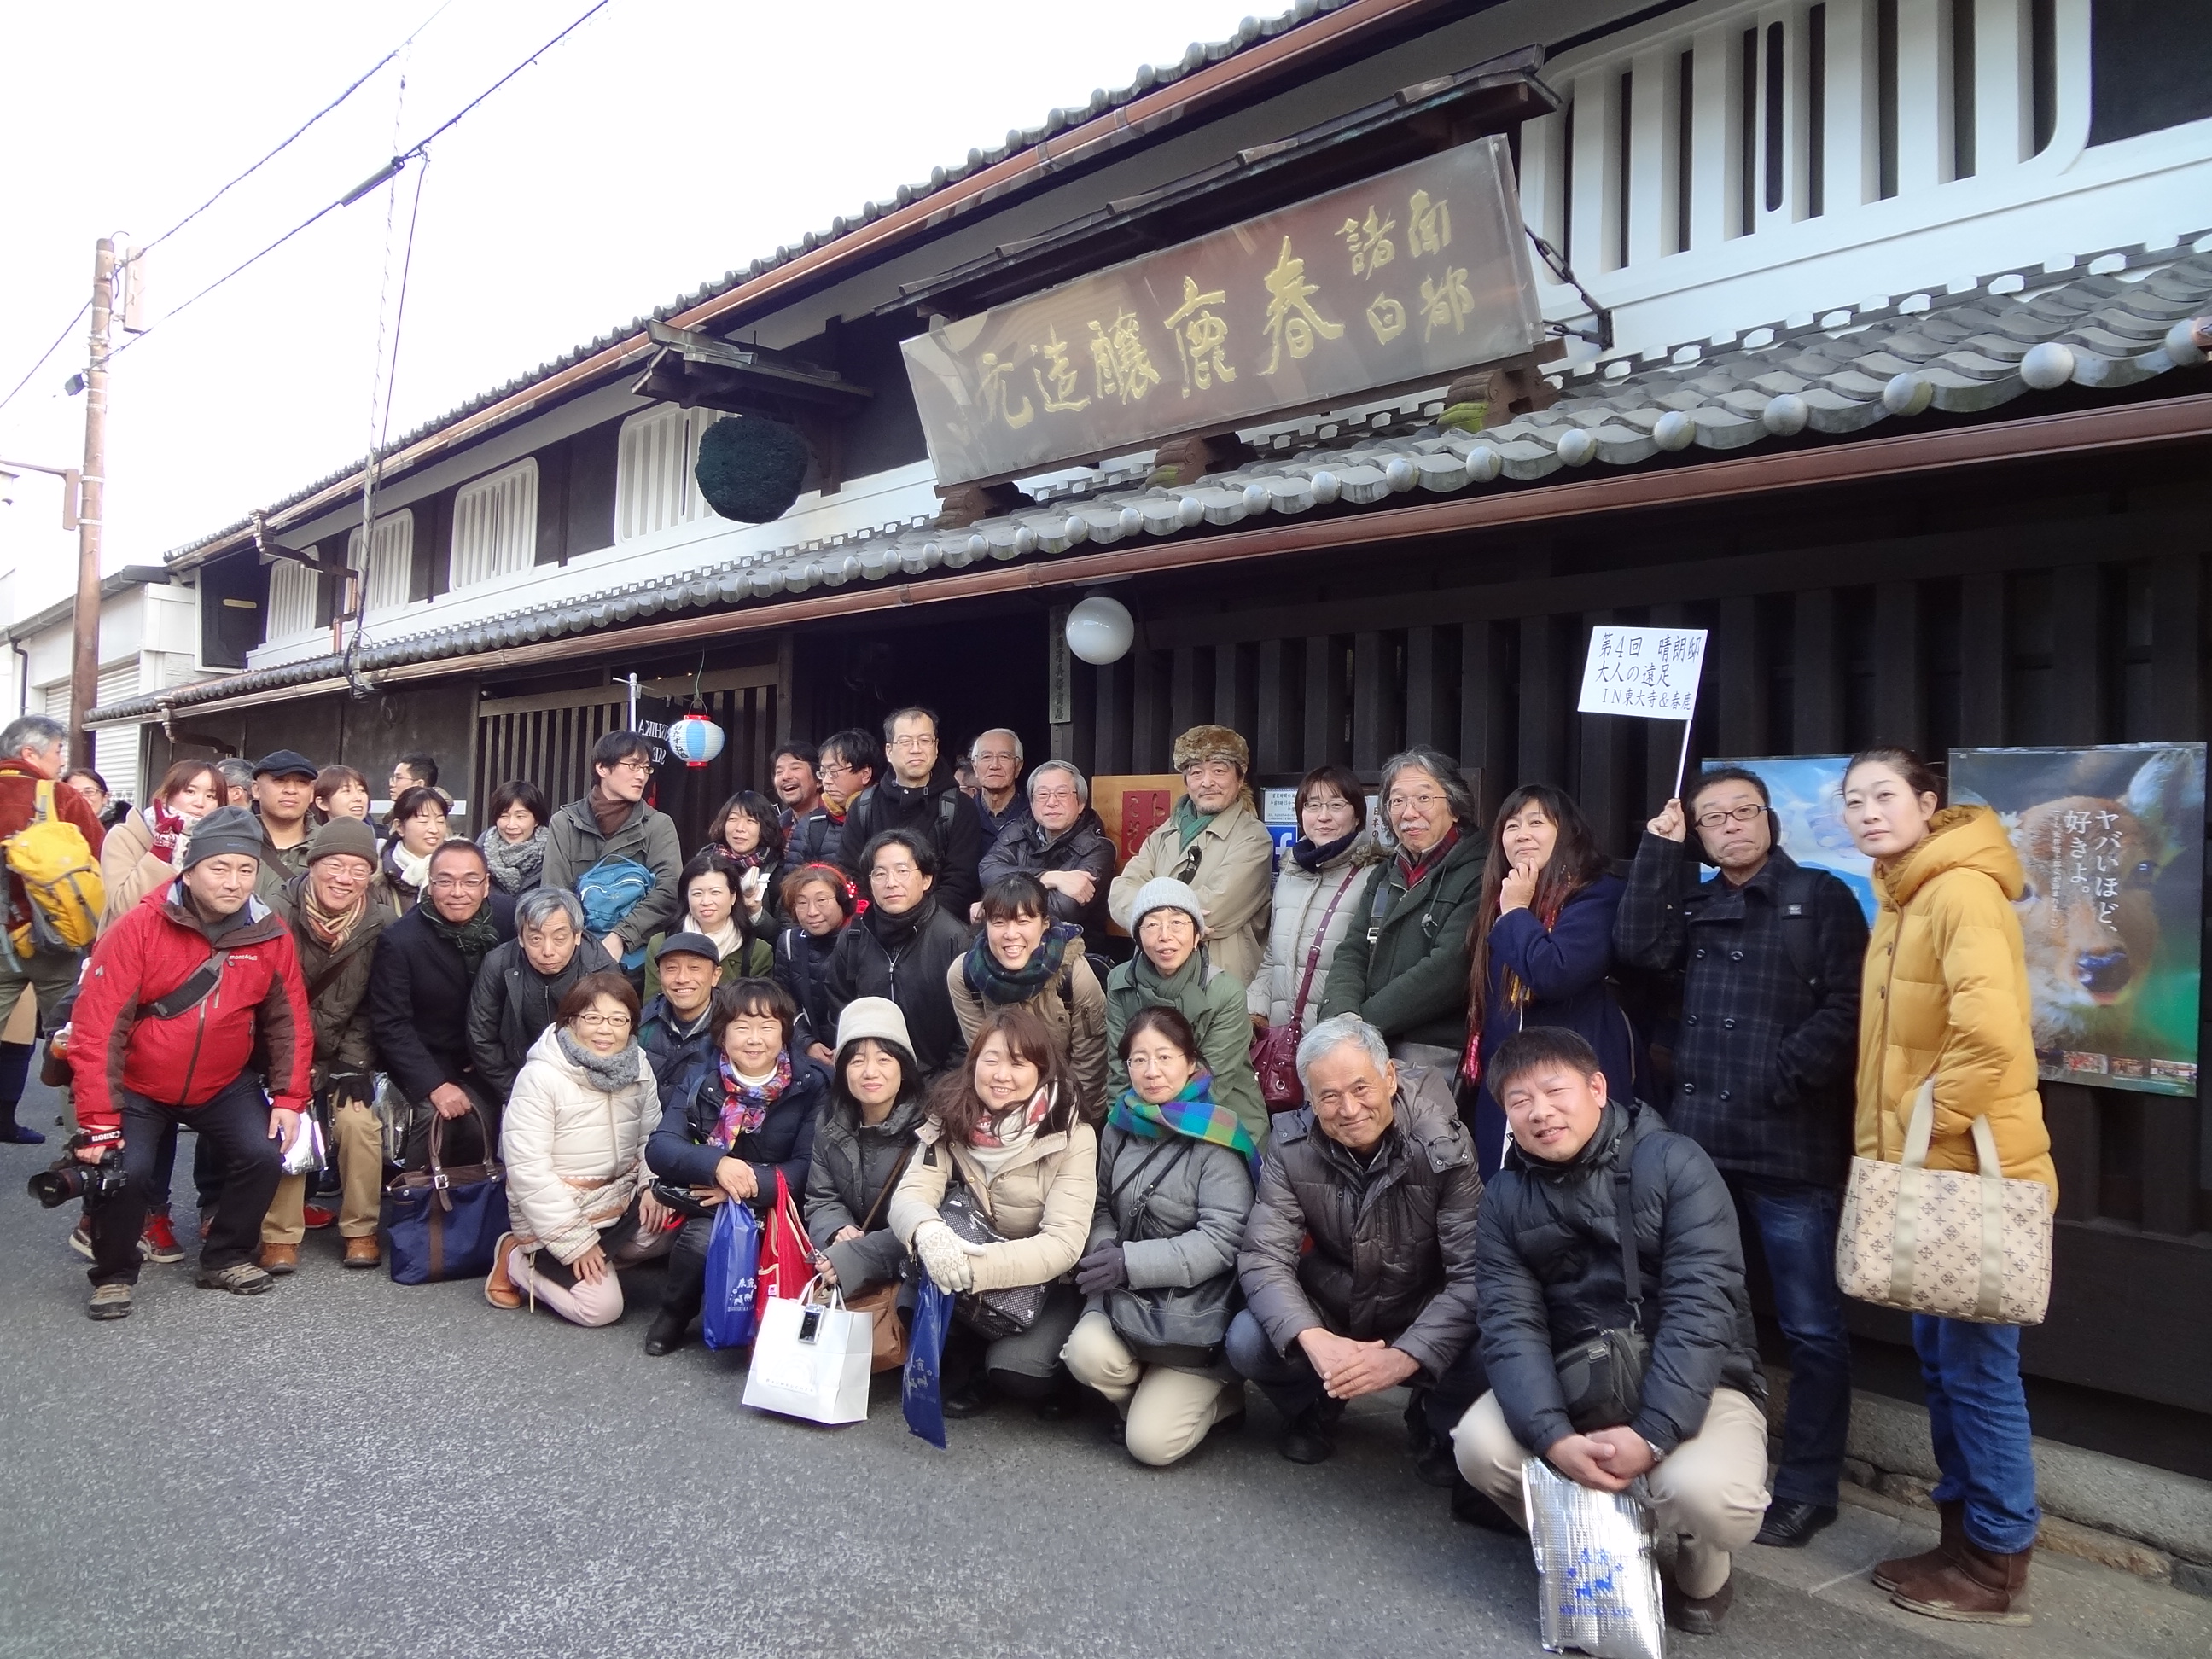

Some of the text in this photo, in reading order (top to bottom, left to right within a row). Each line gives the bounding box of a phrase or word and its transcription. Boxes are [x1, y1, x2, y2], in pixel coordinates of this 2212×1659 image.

[1598, 632, 1703, 664] 第4回 晴朗邸
[1594, 660, 1672, 688] 大人の遠足
[2064, 810, 2093, 894] 好きよ。
[2095, 810, 2123, 932] ヤバいほど、
[91, 1130, 122, 1142] Canon
